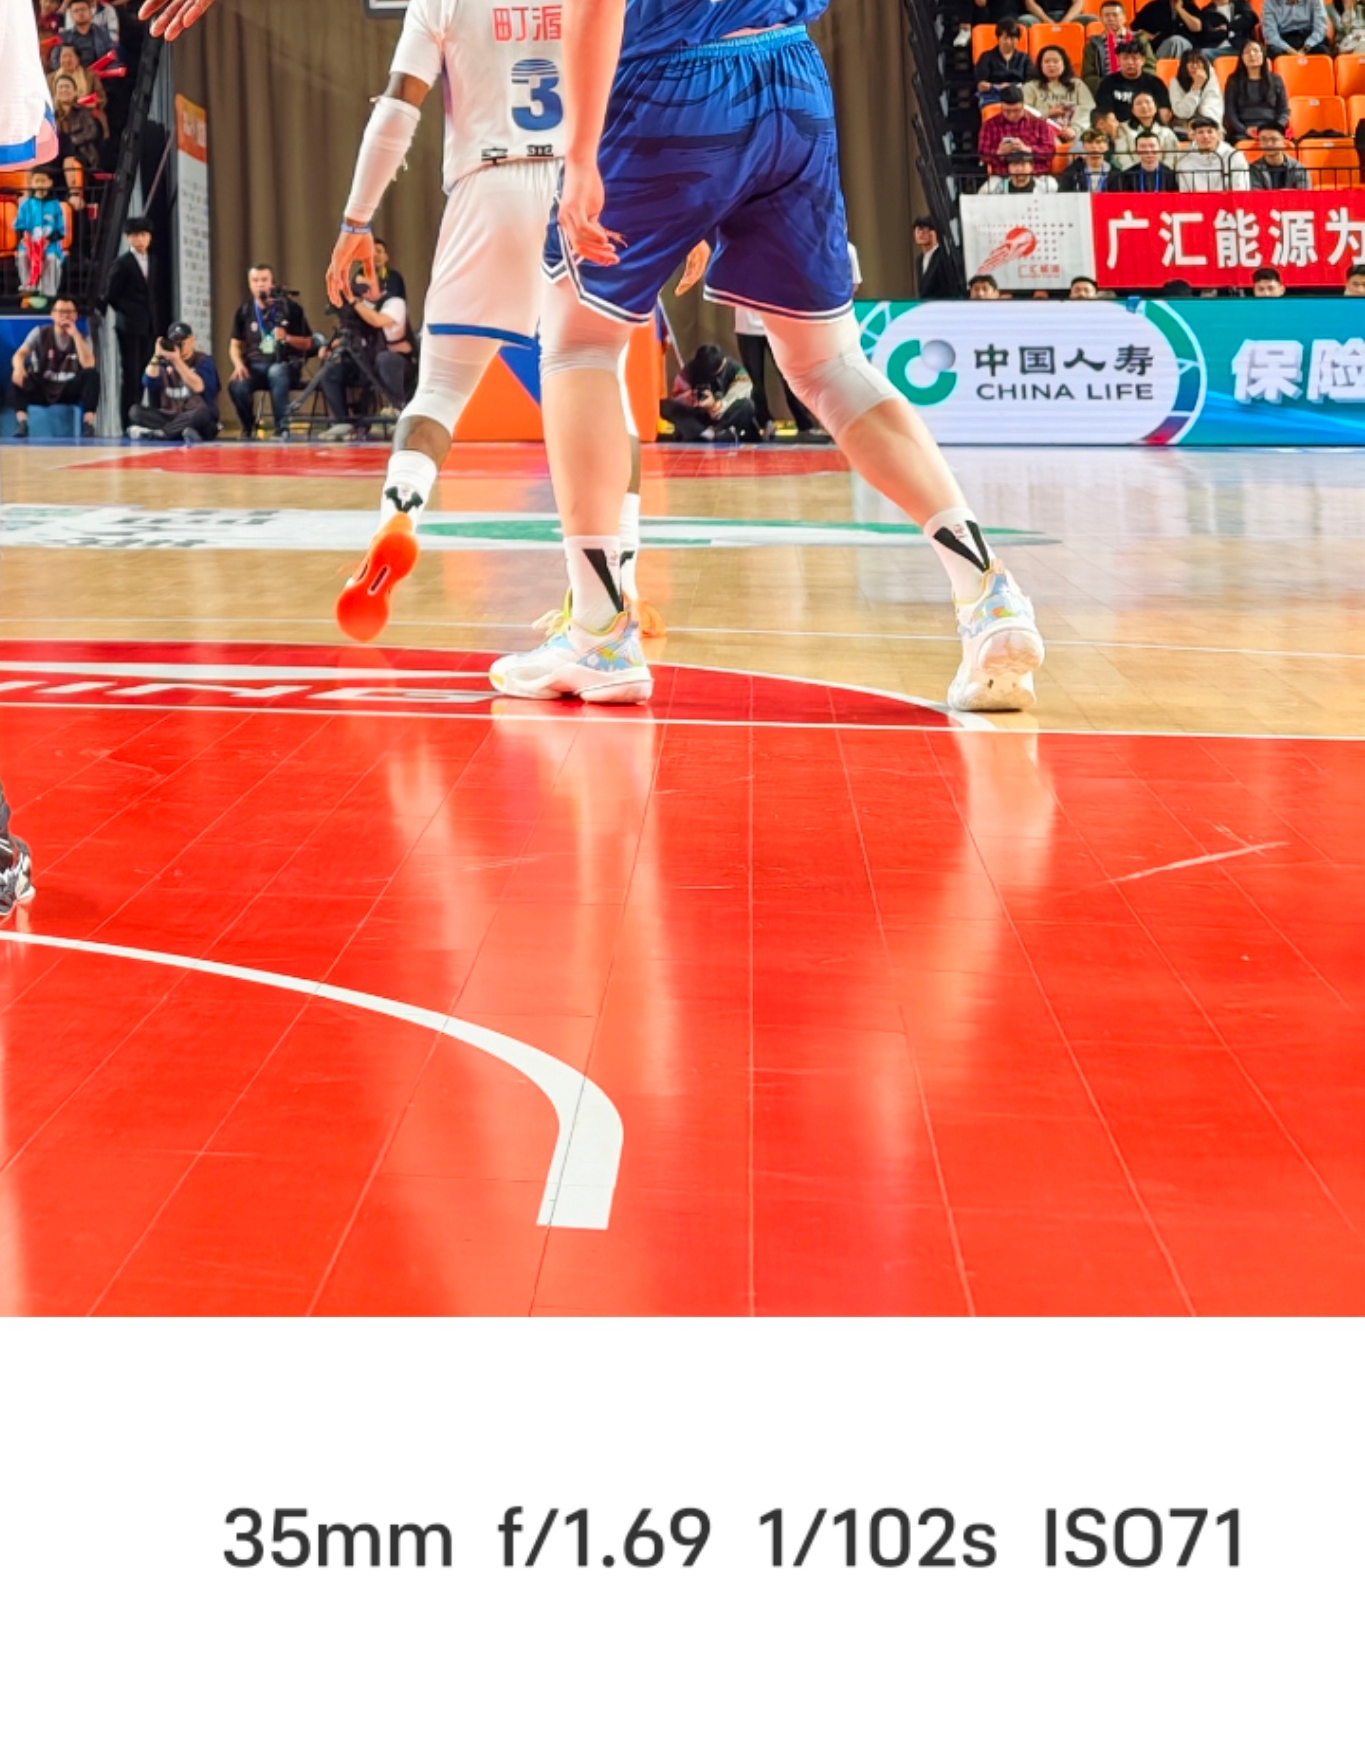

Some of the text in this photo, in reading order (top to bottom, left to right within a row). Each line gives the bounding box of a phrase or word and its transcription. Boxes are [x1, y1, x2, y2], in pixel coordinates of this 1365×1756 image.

[511, 58, 564, 132] 3
[1106, 207, 1365, 269] 广汇能源为
[974, 343, 1156, 377] 中国人寿
[976, 383, 1155, 401] CHINA LIFE
